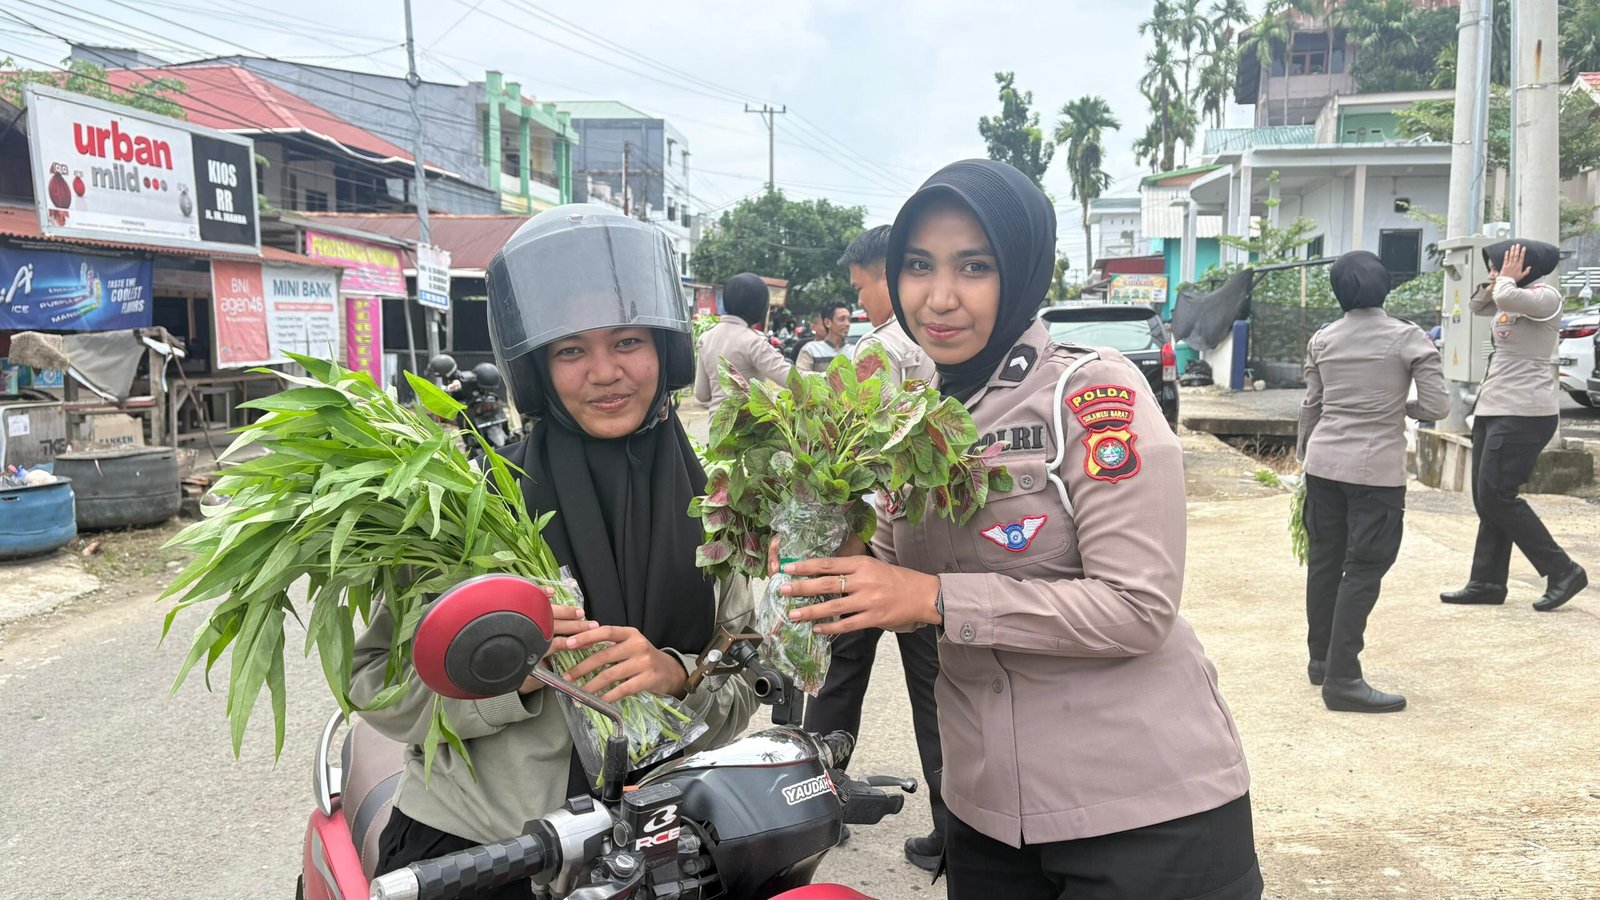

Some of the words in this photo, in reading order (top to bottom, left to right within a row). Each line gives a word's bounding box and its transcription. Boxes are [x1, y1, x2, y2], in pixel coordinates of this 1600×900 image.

[73, 120, 173, 170] urban
[91, 163, 141, 193] mild
[207, 159, 238, 187] KIOS
[215, 188, 234, 213] RR
[231, 277, 250, 293] BNI
[272, 279, 299, 296] MINI
[302, 280, 332, 298] BANK
[11, 305, 30, 314] ICE
[220, 296, 263, 315] agen46
[1072, 388, 1129, 407] POLDA
[1083, 410, 1109, 423] SULAWESI
[1110, 410, 1129, 419] BARAT
